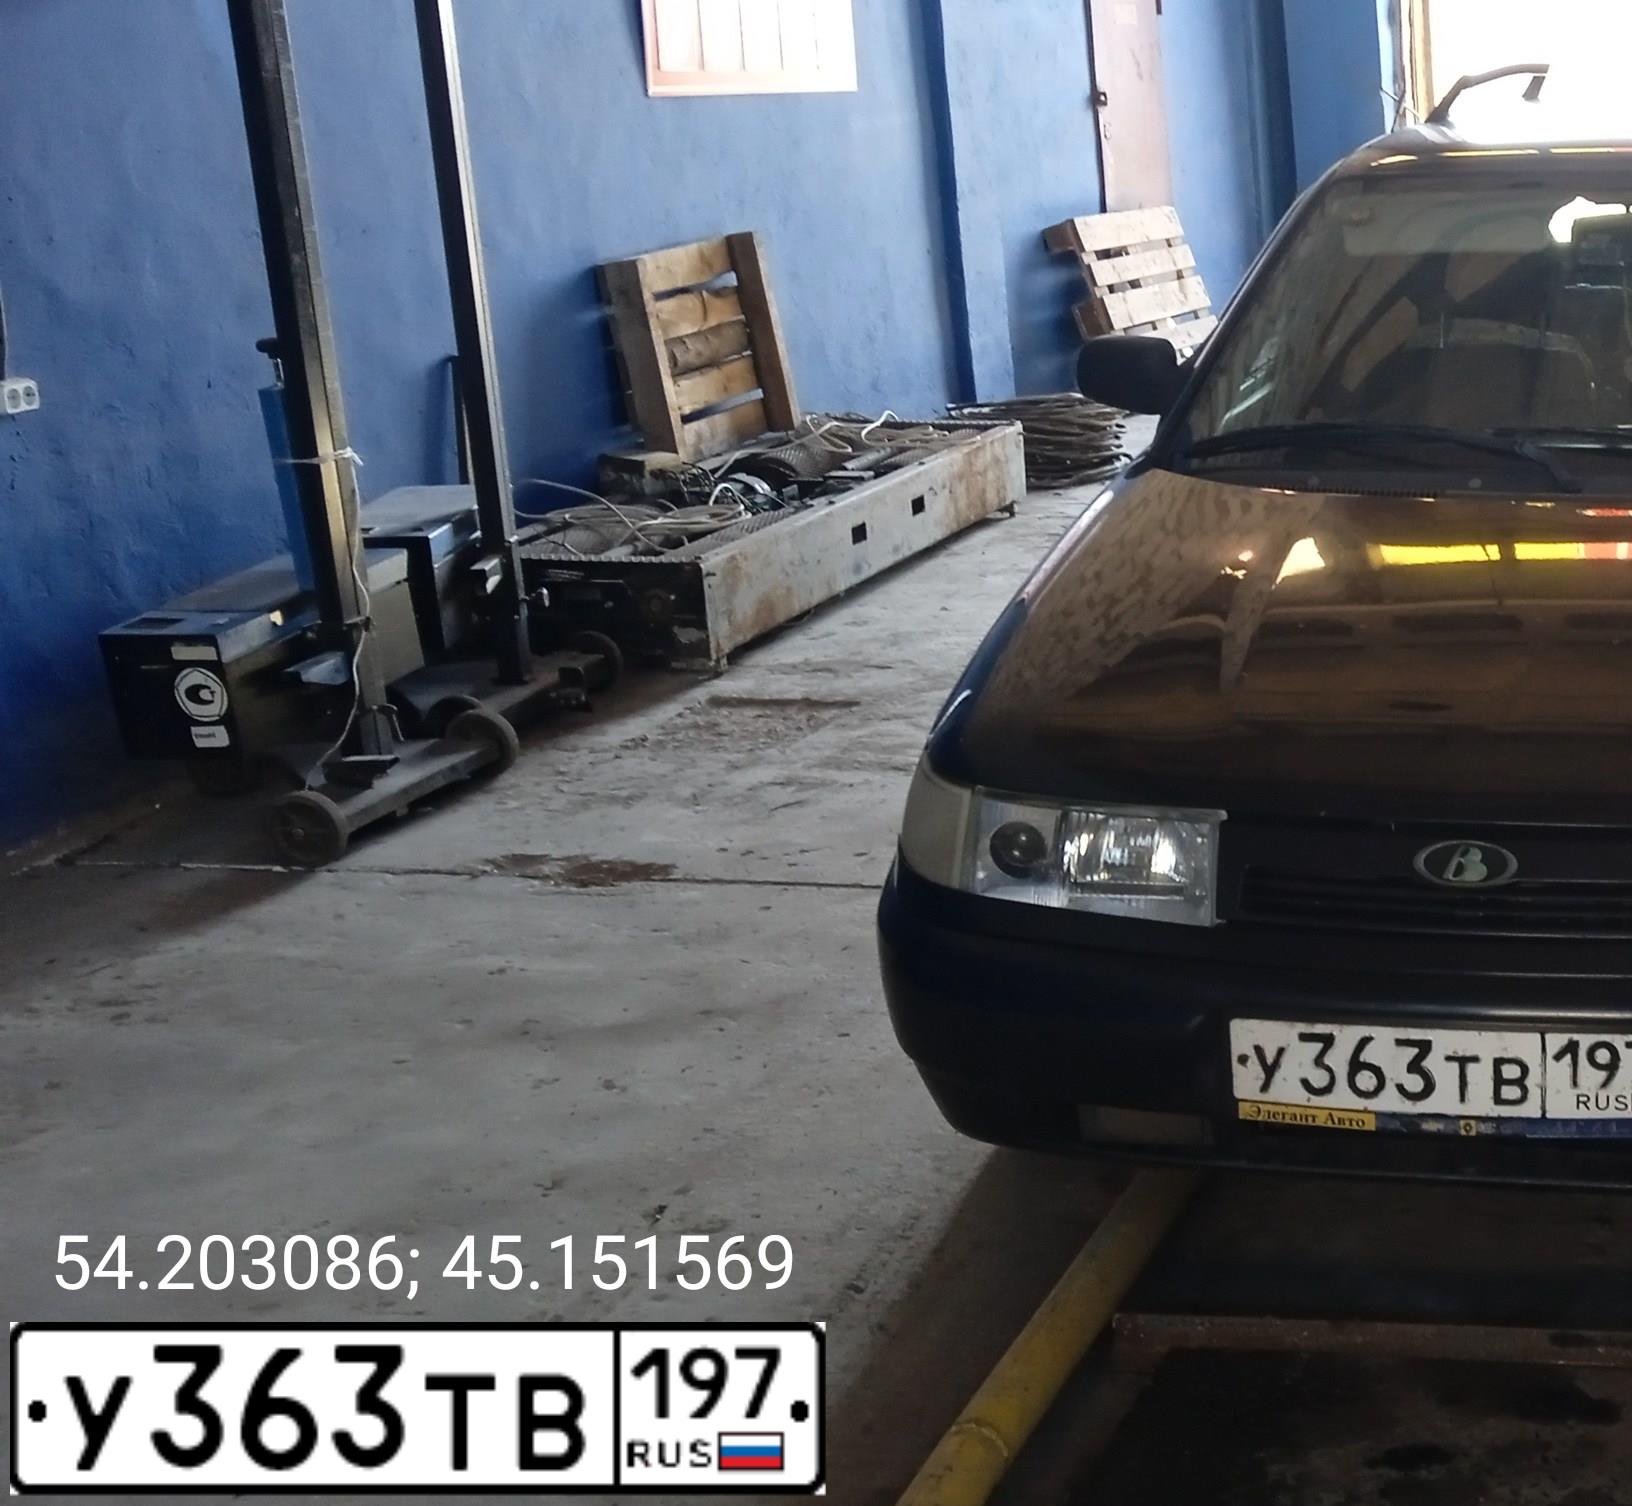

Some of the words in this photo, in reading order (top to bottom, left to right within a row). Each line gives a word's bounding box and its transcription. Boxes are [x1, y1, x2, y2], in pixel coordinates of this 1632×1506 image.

[1576, 1093, 1628, 1111] RUS
[1247, 1104, 1318, 1124] Элегант
[1323, 1111, 1366, 1129] Авто
